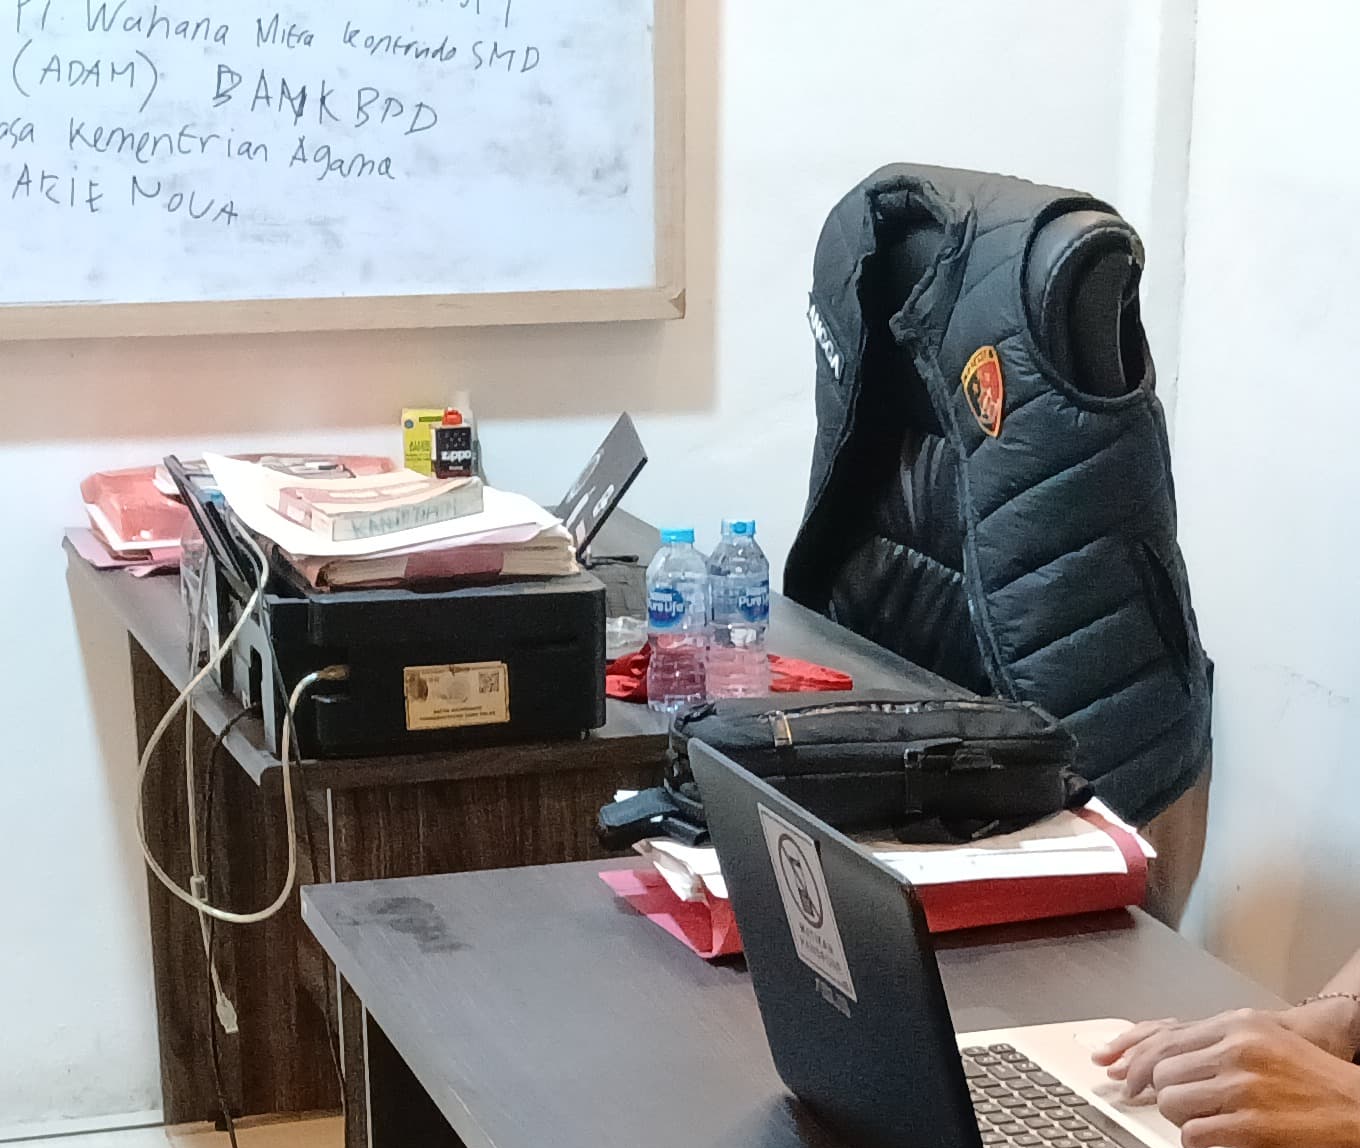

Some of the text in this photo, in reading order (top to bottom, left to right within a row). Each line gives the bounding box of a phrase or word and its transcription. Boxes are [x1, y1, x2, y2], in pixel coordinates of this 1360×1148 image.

[86, 0, 230, 44] Wahana
[255, 13, 314, 48] Mitra
[472, 40, 541, 73] SMD
[13, 38, 158, 112] (ADAM)
[354, 87, 438, 136] BPD
[290, 135, 396, 181] Agama
